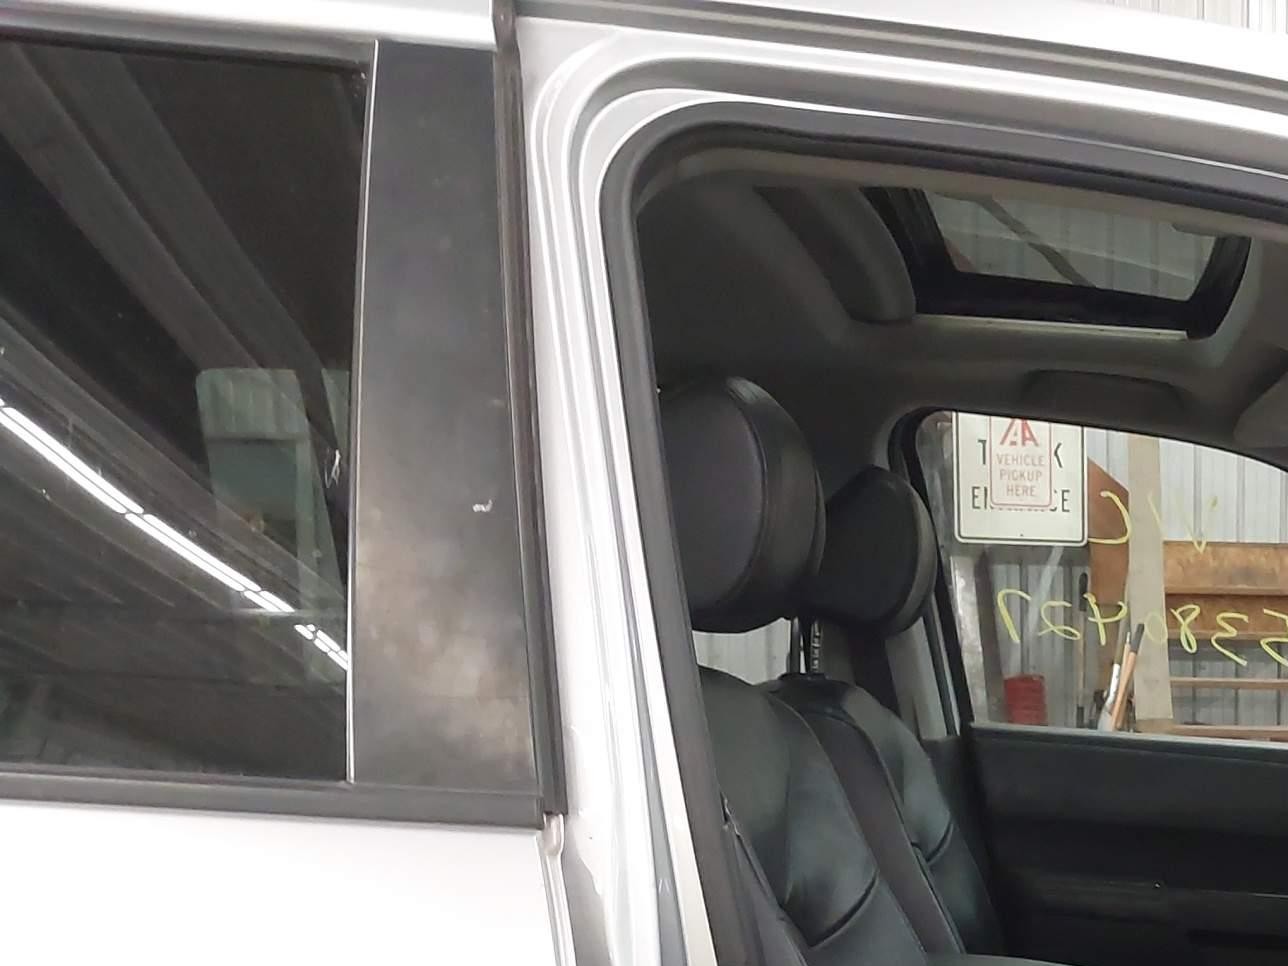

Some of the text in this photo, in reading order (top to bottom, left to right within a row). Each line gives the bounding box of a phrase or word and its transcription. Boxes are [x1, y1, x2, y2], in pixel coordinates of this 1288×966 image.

[996, 453, 1046, 467] VEHICLE
[1000, 469, 1043, 481] PICKUP
[1006, 484, 1037, 497] HERE
